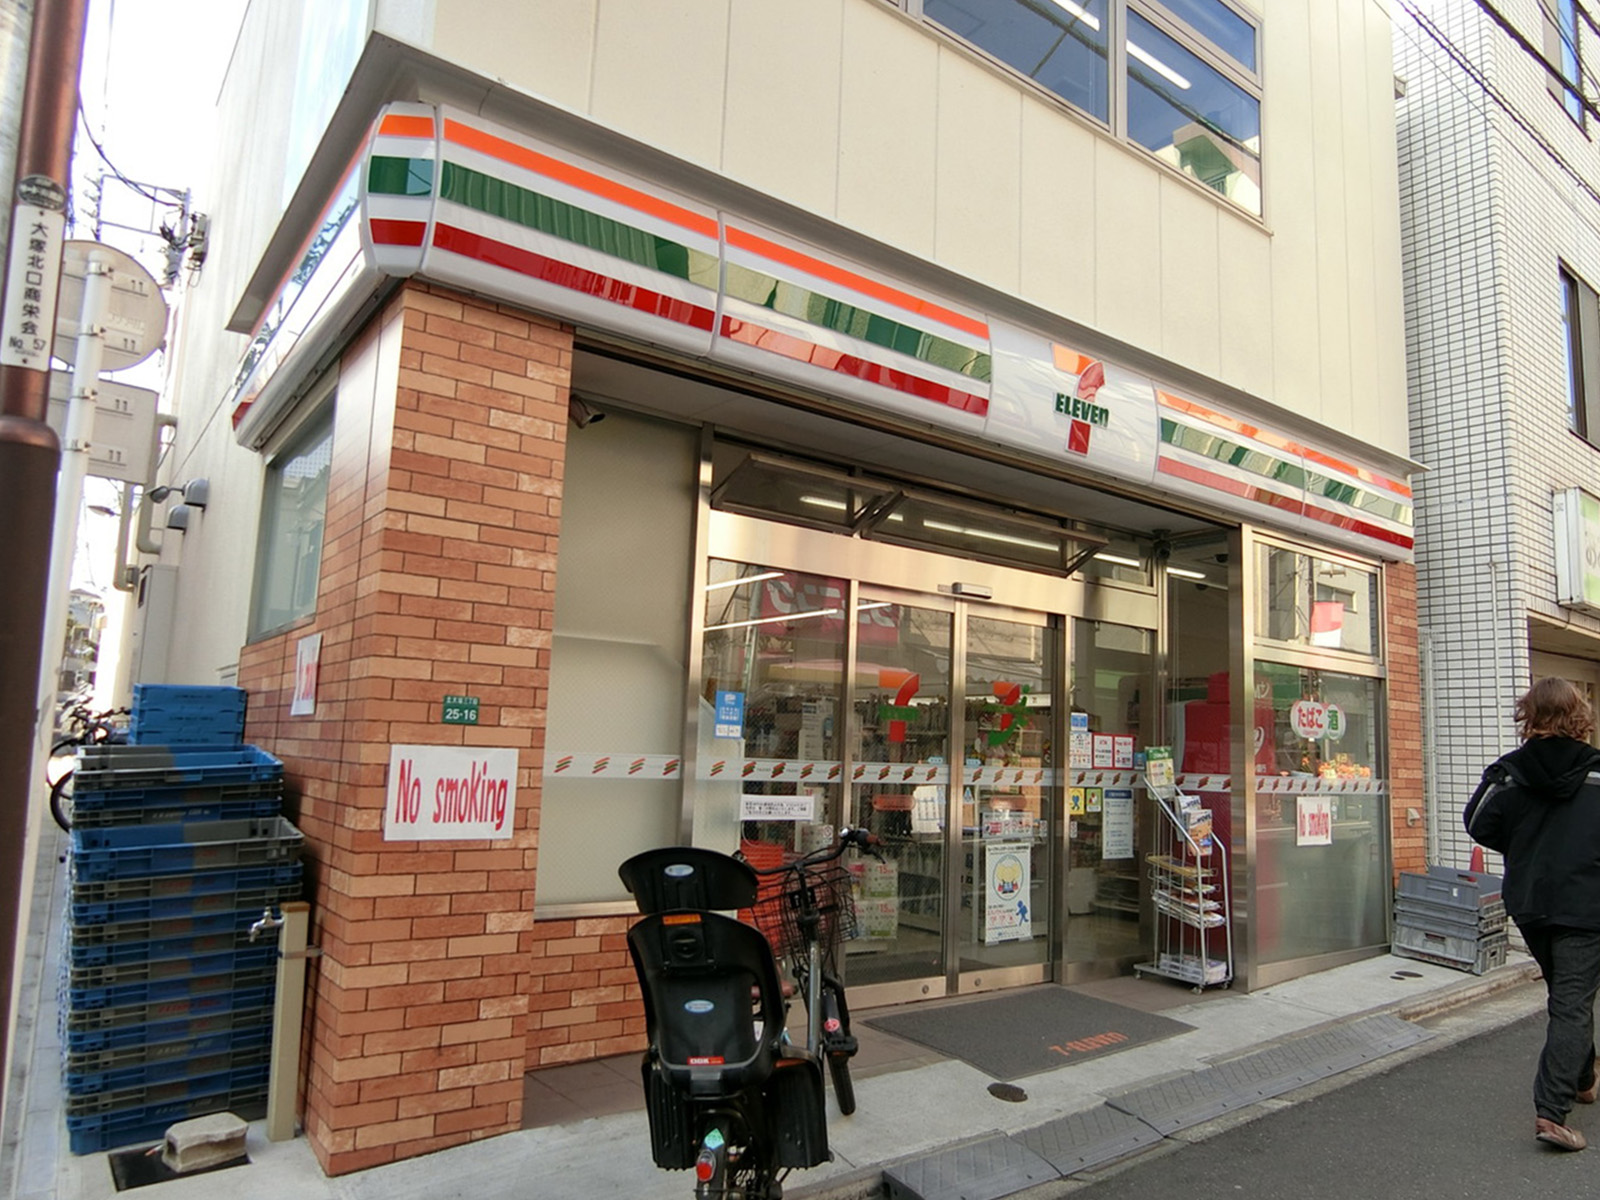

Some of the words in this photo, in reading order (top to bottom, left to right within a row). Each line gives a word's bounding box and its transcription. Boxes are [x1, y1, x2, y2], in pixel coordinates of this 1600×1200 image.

[21, 222, 49, 336] 大塚北口商栄会
[33, 338, 47, 351] 57
[1297, 706, 1323, 728] たばこ
[1327, 709, 1339, 731] 酒
[395, 759, 421, 824] No
[433, 760, 508, 831] smoking
[1309, 804, 1329, 840] smoking
